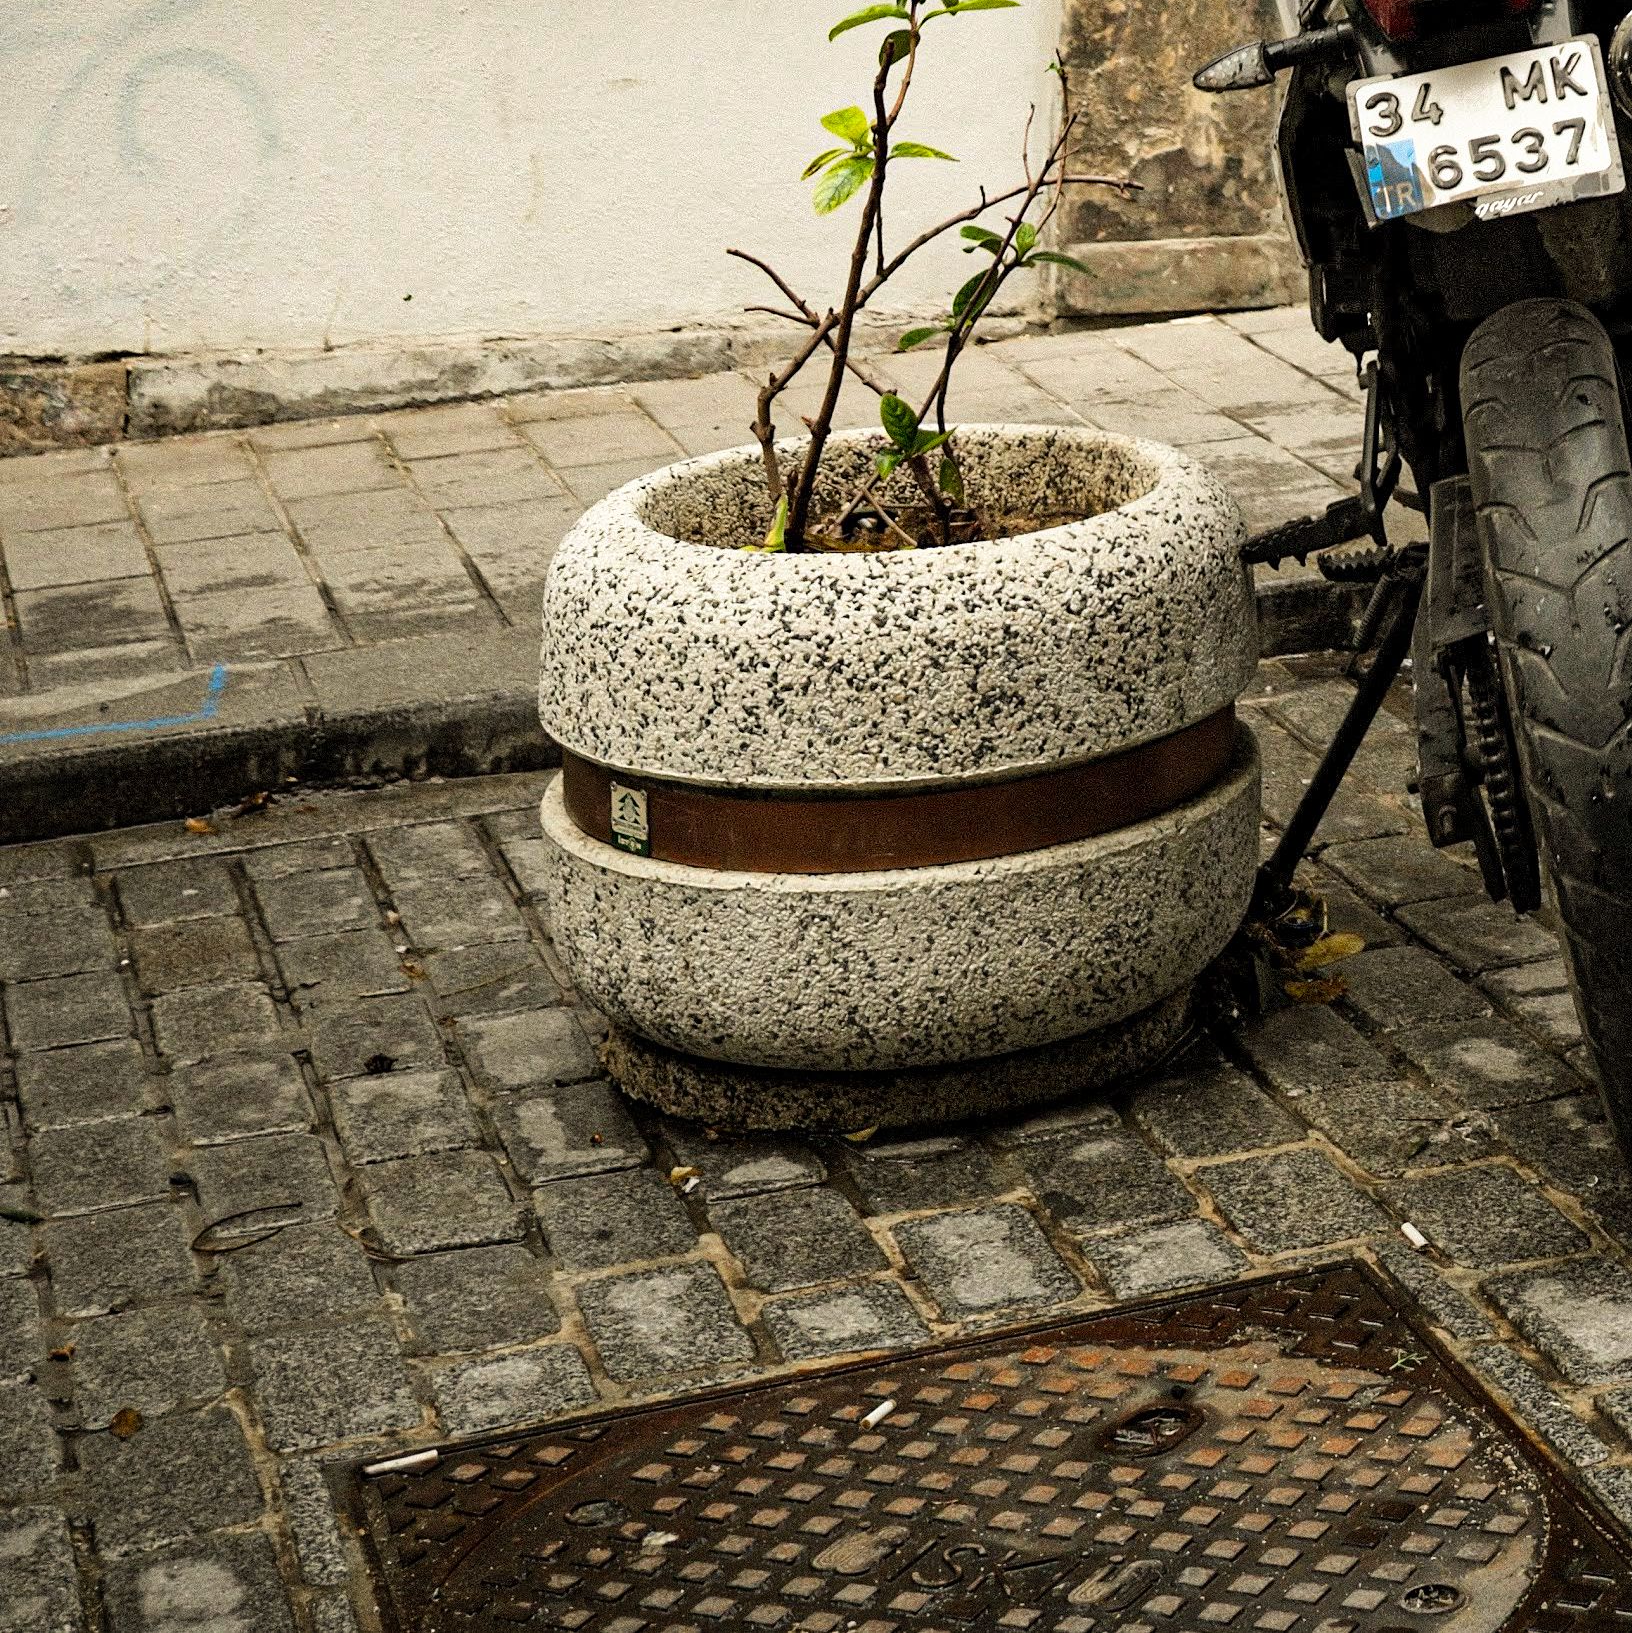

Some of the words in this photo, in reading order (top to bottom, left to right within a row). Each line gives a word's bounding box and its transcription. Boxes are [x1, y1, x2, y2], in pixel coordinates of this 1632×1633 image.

[1364, 82, 1445, 137] 34
[1498, 51, 1588, 110] MK
[1427, 117, 1587, 189] 6537
